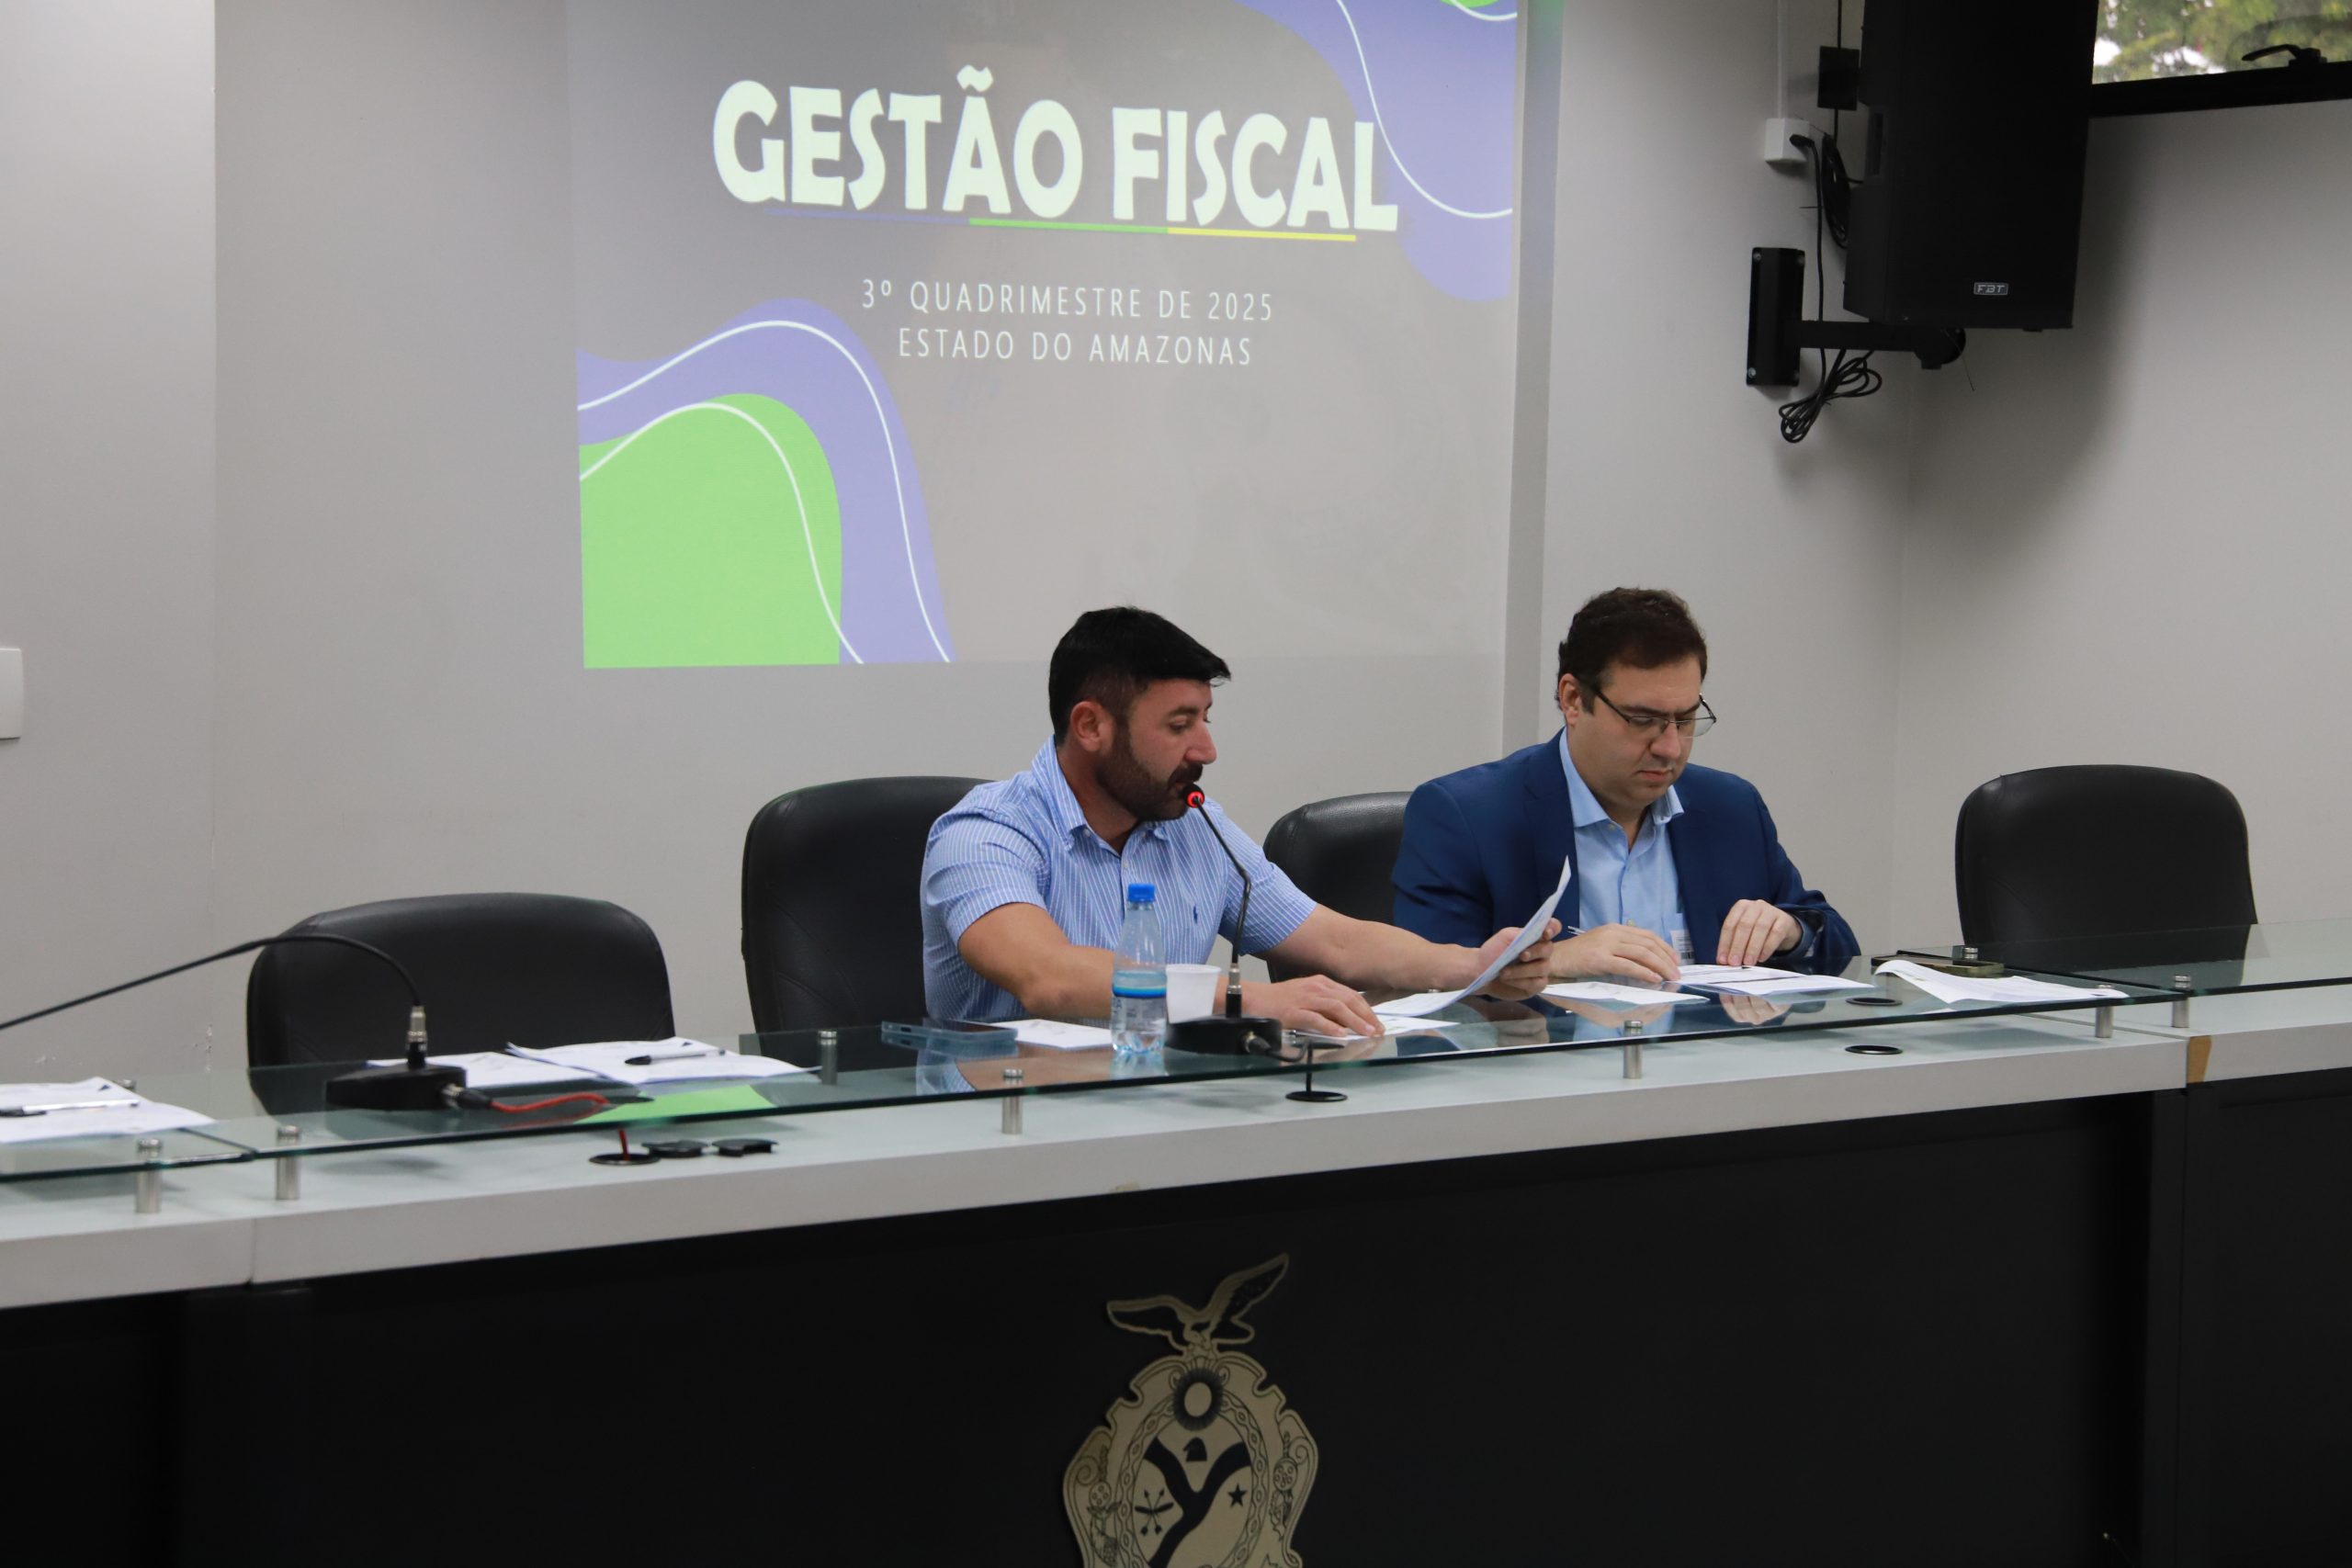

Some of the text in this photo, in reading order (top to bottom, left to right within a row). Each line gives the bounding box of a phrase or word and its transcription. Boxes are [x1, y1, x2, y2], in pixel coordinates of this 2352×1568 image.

[712, 64, 1398, 231] GESTÃO FISCAL
[862, 278, 1272, 321] 3º QUADRIMESTRE DE 2025
[1977, 284, 2006, 293] FBT
[899, 328, 1250, 366] ESTADO DO AMAZONAS
